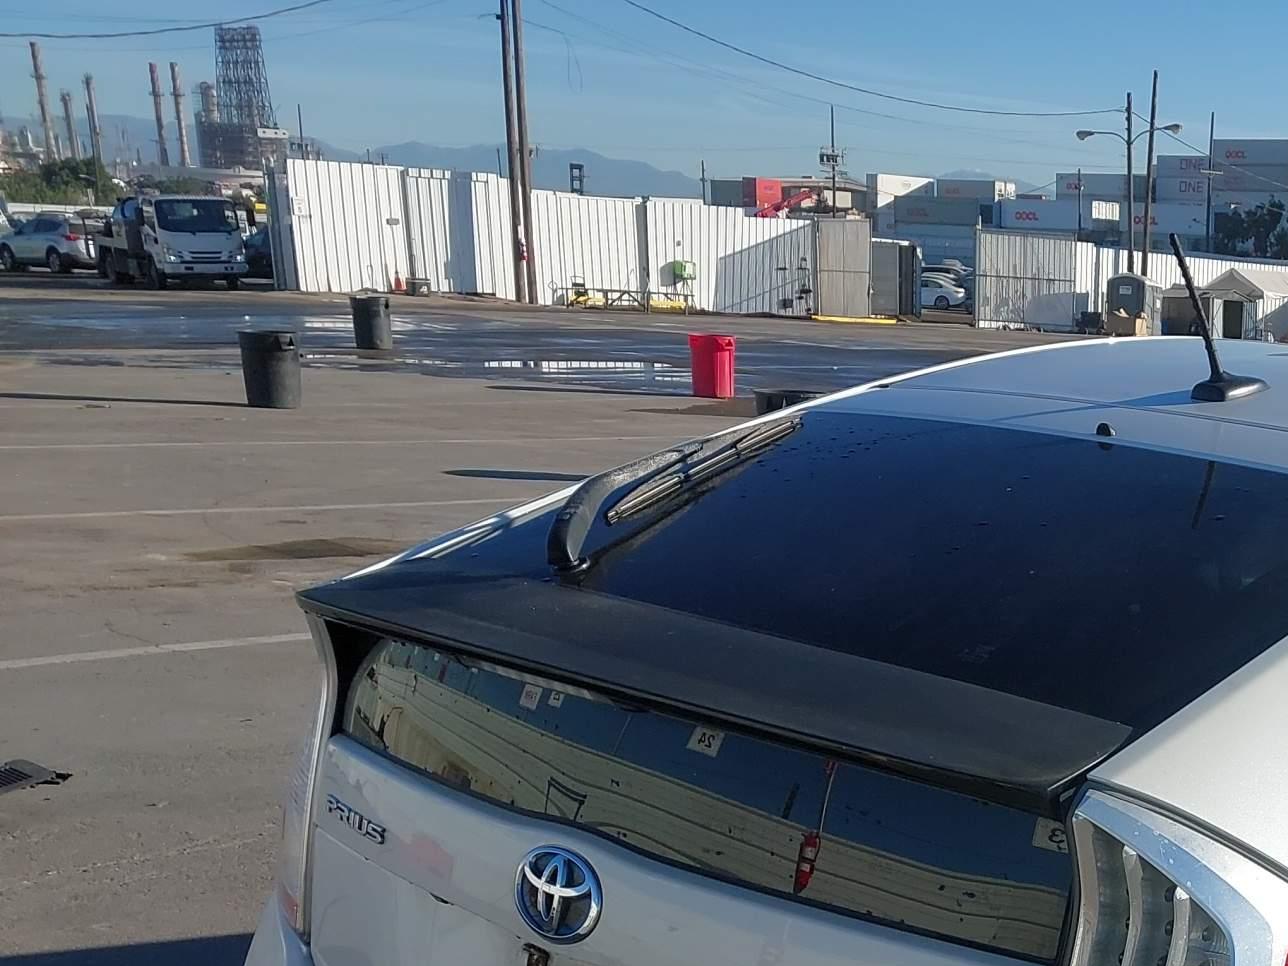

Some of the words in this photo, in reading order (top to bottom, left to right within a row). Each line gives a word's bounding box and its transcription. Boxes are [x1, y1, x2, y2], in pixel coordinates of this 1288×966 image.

[1179, 158, 1205, 170] ONE
[1178, 180, 1204, 193] ONE
[1014, 210, 1040, 222] OOCL
[326, 793, 387, 846] PRIUS
